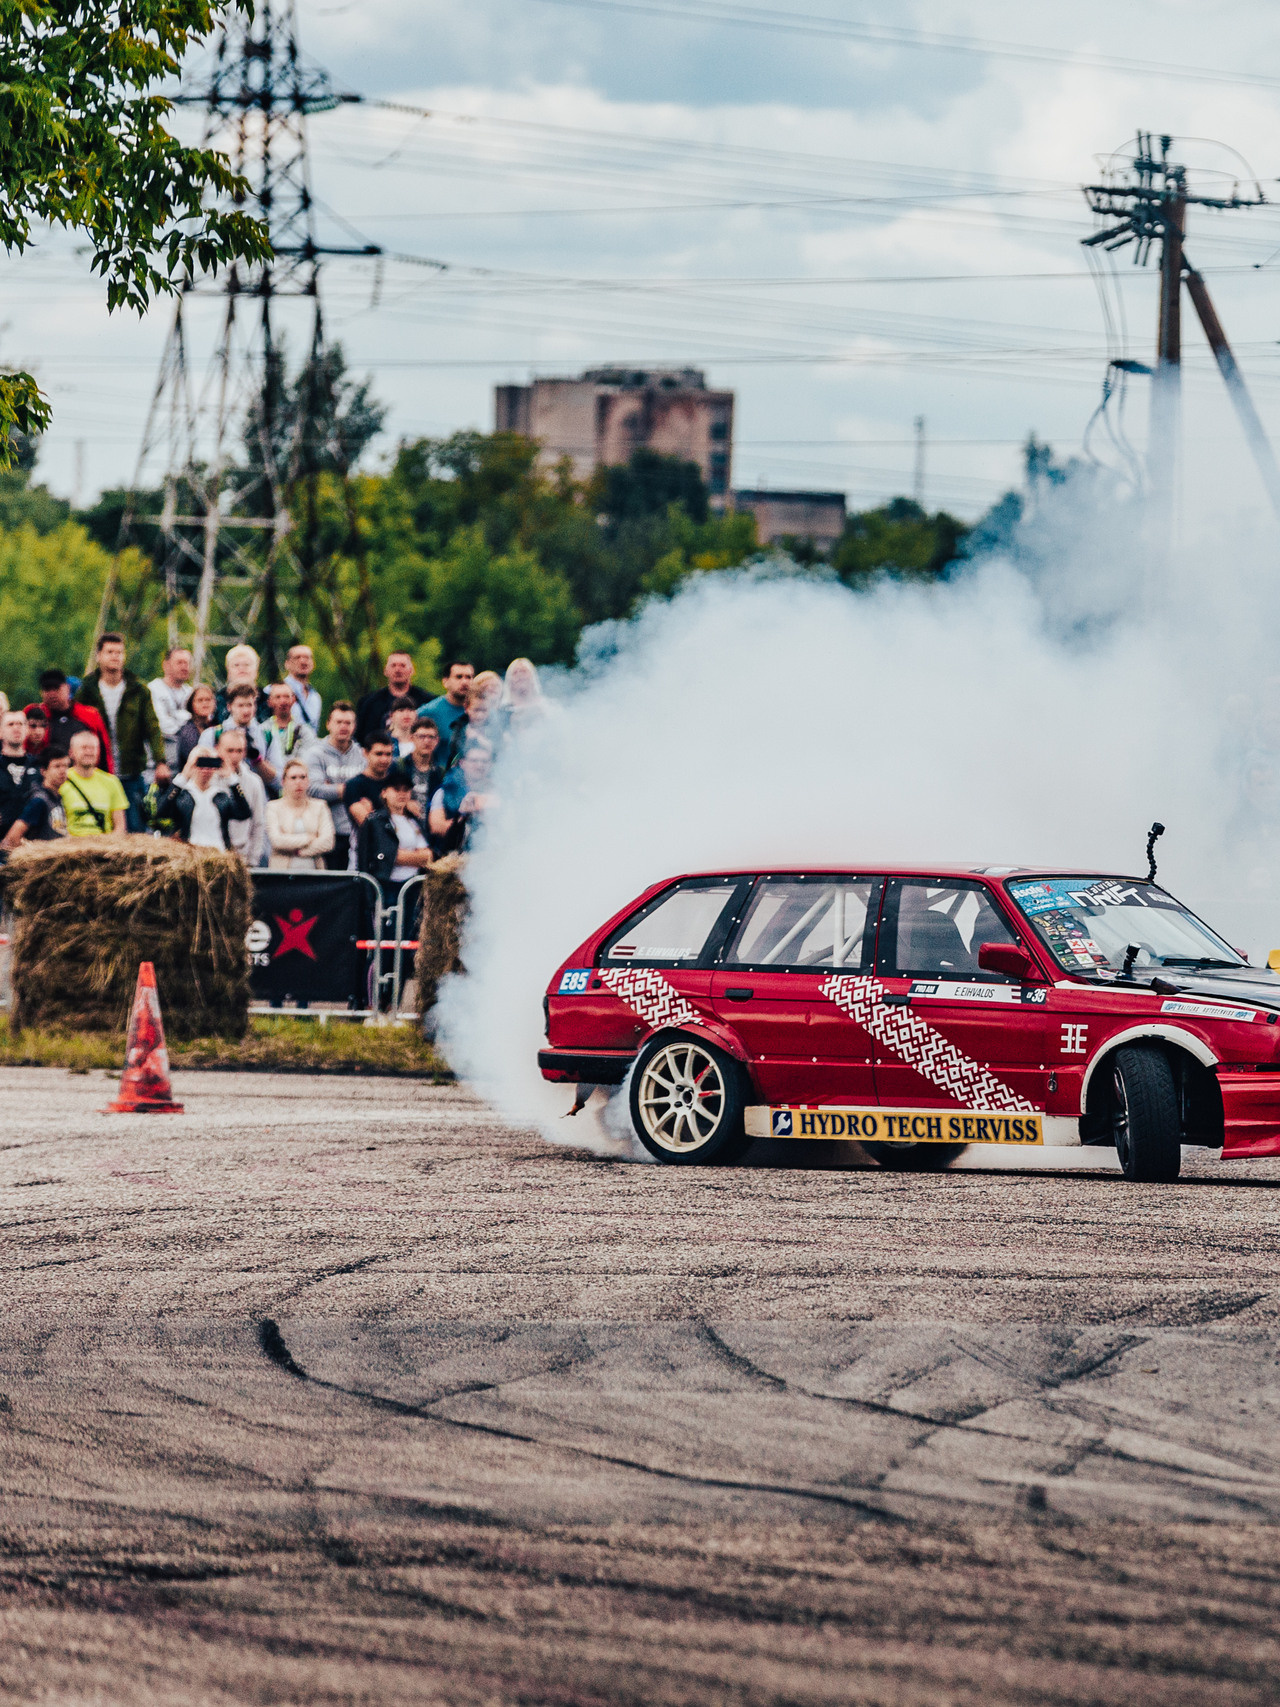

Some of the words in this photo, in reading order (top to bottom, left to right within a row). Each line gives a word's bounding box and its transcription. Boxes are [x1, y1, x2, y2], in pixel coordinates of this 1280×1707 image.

[559, 972, 590, 991] E85
[800, 1112, 877, 1136] HYDRO
[884, 1115, 942, 1139] TECH
[949, 1117, 1039, 1142] SERVISS
